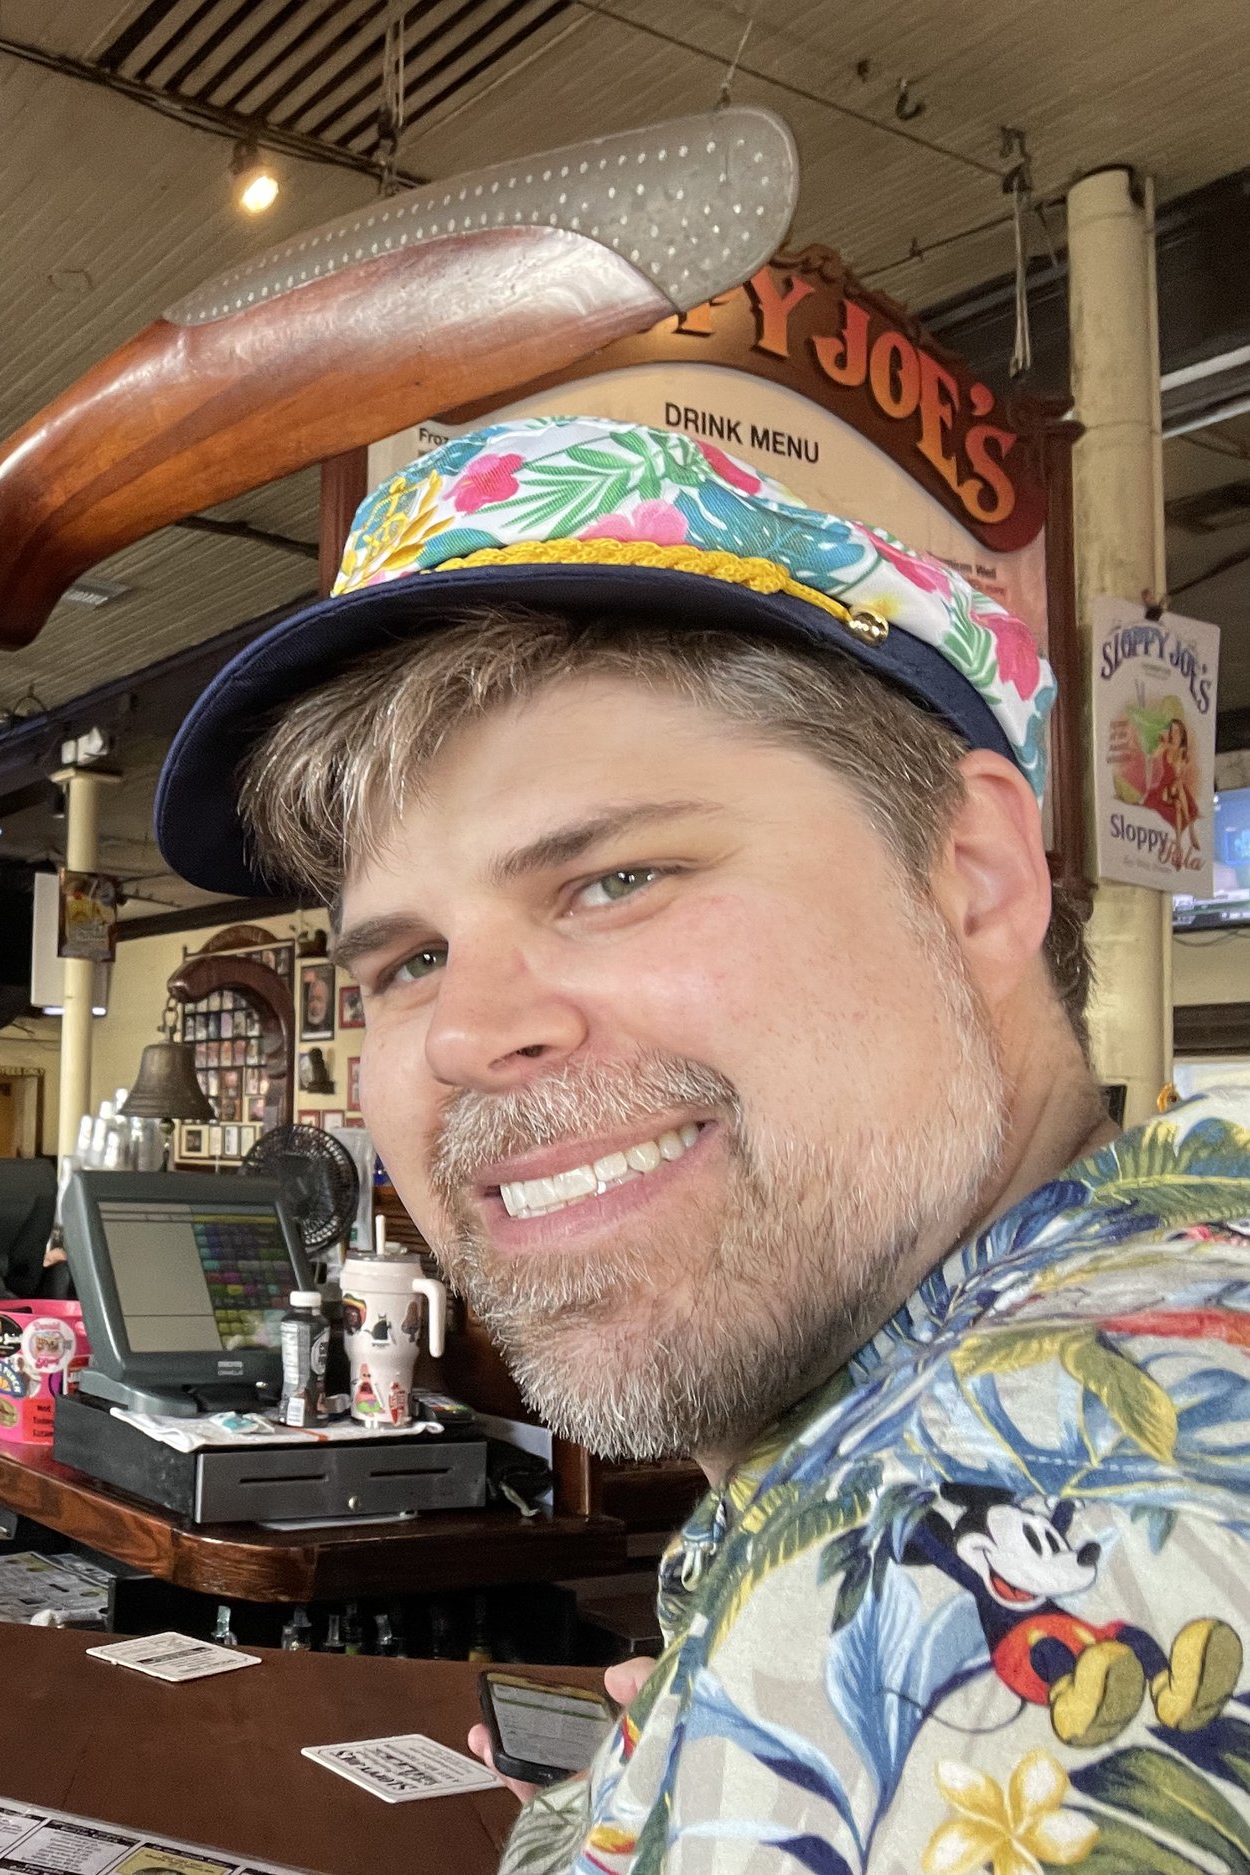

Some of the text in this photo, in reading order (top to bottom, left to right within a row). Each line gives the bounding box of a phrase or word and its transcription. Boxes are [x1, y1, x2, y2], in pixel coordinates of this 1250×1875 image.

[664, 401, 820, 464] DRINK MENU
[812, 298, 1018, 524] JOE'S
[1100, 624, 1213, 716] SLOPPY JOE'S
[1110, 813, 1169, 853] Sloppy
